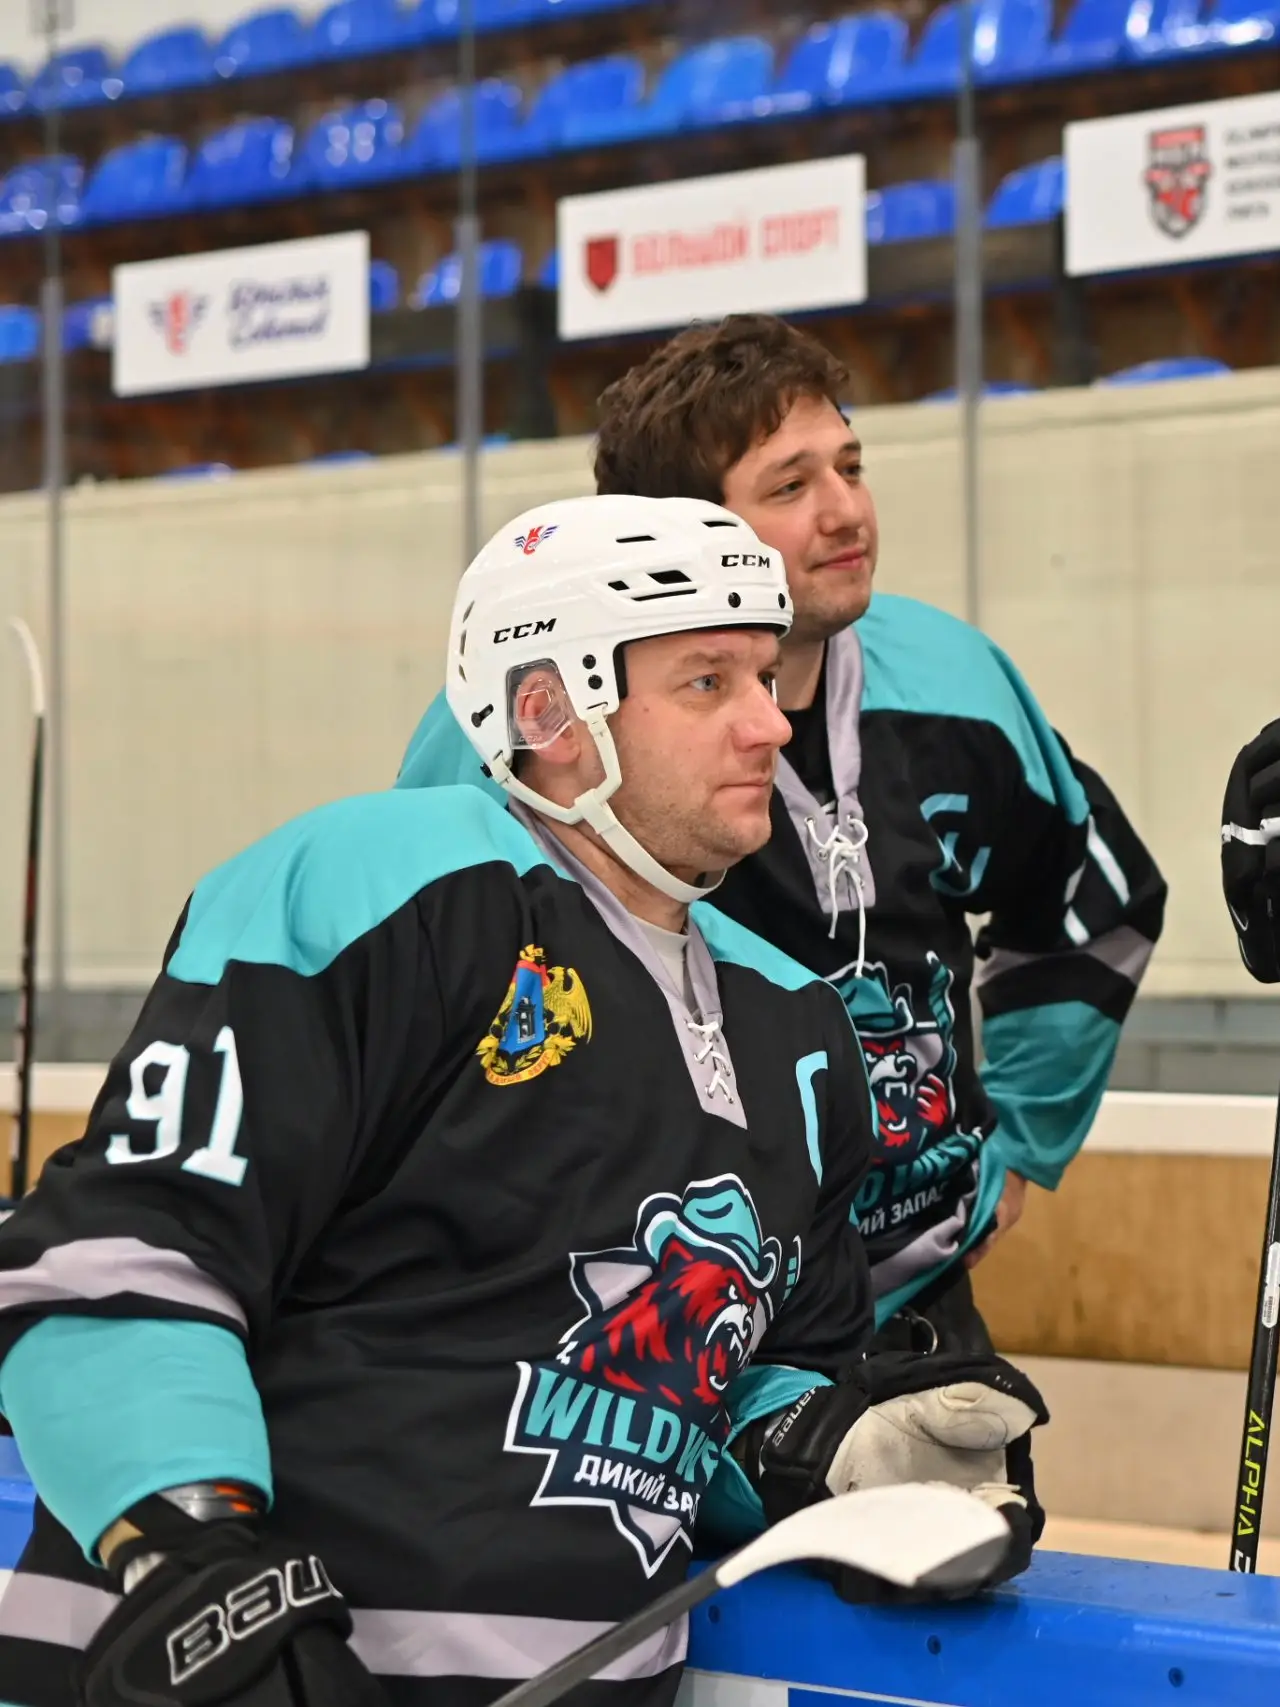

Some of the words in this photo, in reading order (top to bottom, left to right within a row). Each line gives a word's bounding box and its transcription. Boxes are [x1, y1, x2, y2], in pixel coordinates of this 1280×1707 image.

[720, 554, 771, 569] CCM
[493, 618, 557, 644] CCM
[105, 1026, 248, 1187] 91
[524, 1367, 682, 1464] WILD
[573, 1453, 666, 1505] ДИКИЙ
[1237, 1410, 1266, 1536] ALPHA
